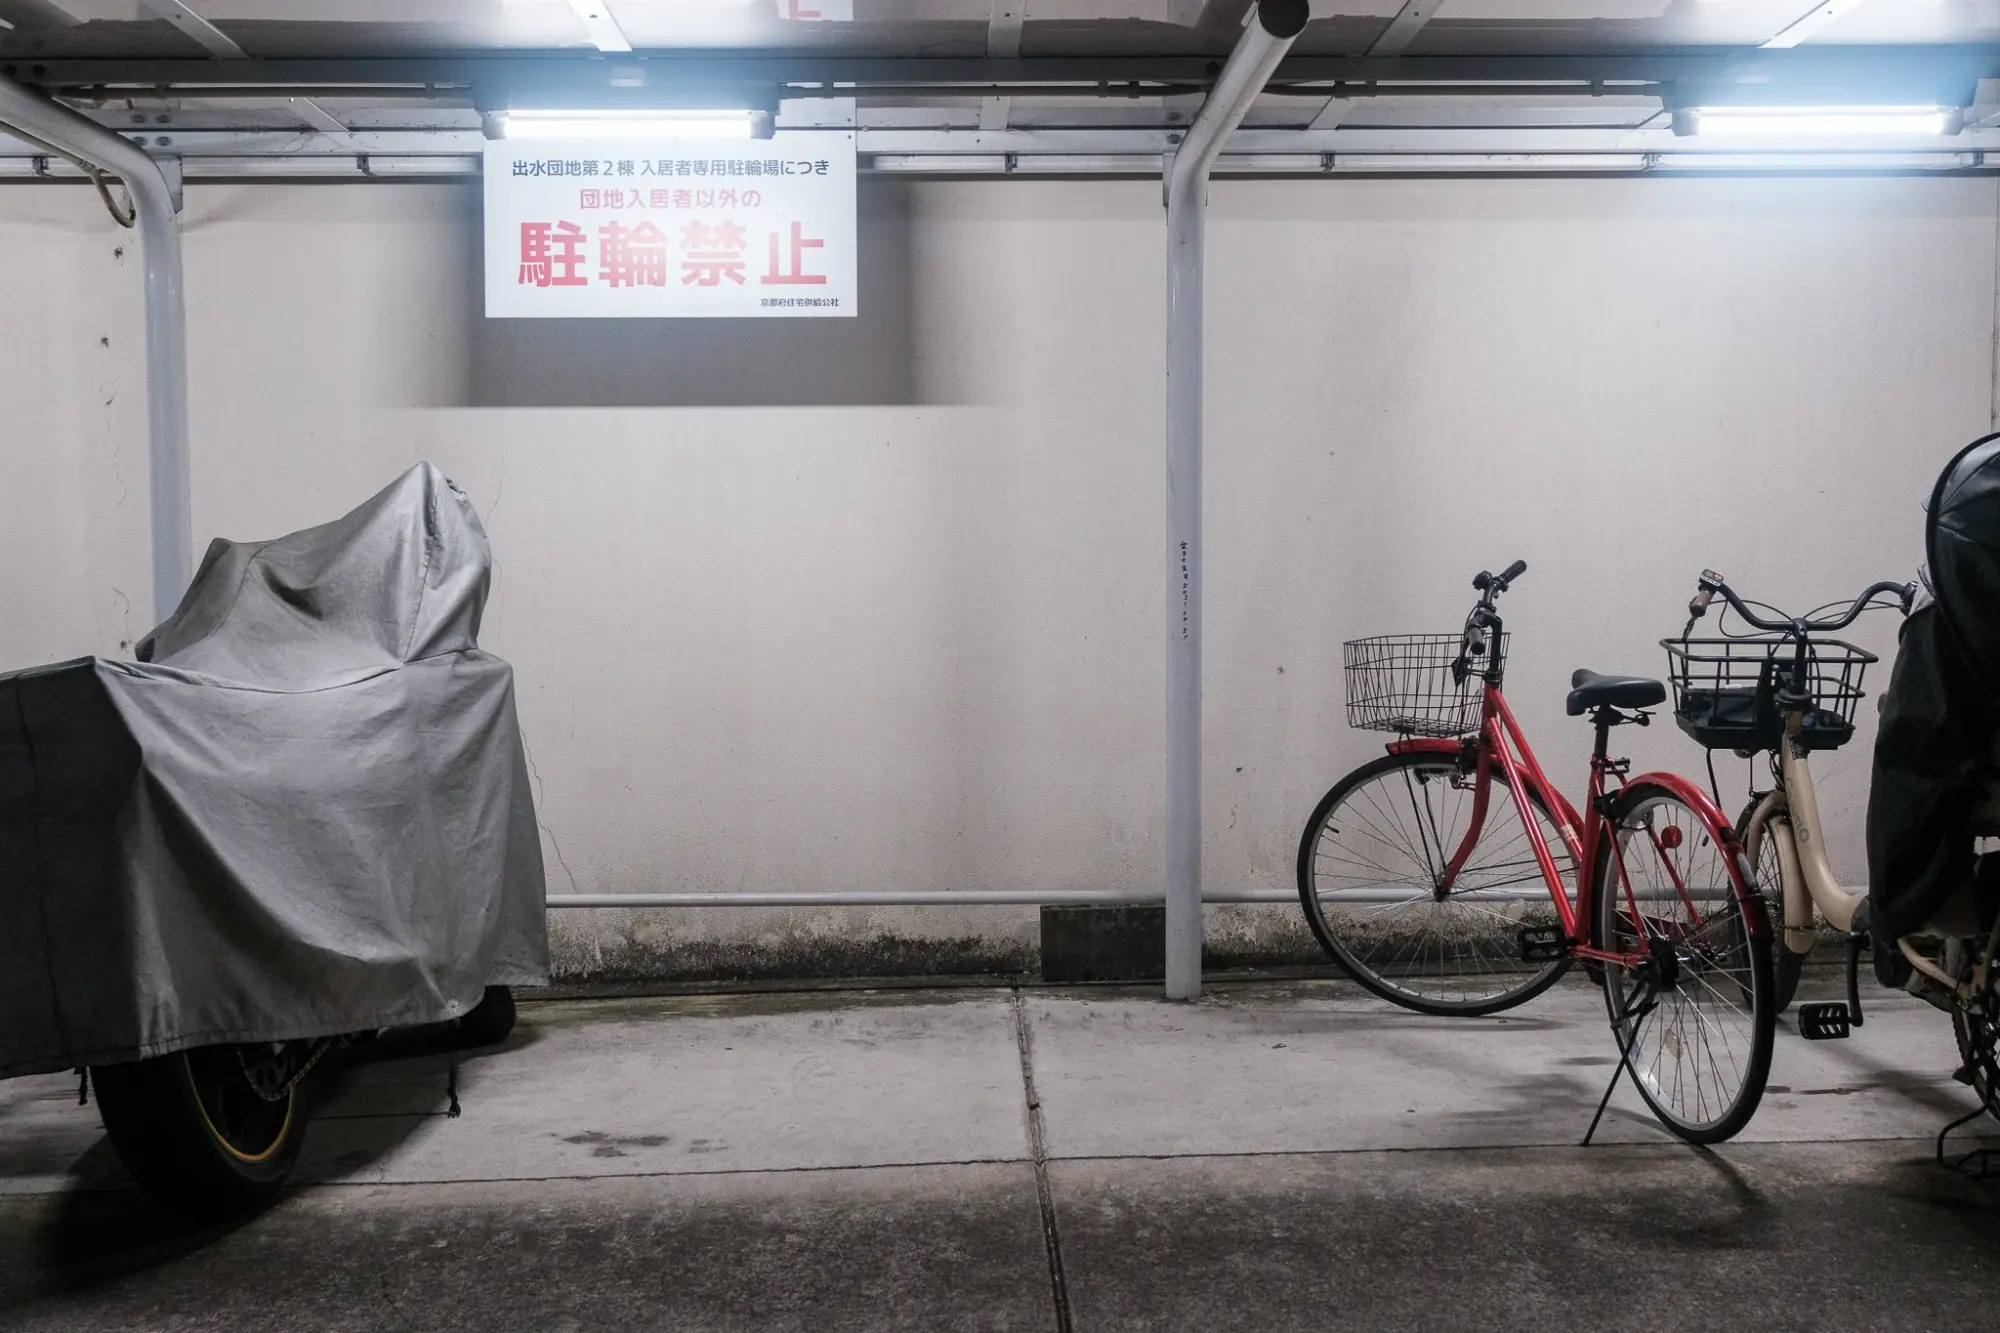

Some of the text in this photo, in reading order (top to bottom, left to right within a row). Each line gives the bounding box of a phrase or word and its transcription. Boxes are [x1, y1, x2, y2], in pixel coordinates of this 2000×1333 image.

[579, 188, 762, 210] 団地入居者以外の
[517, 220, 828, 288] 駐輪禁止
[760, 297, 840, 308] 京都府住宅供給公社
